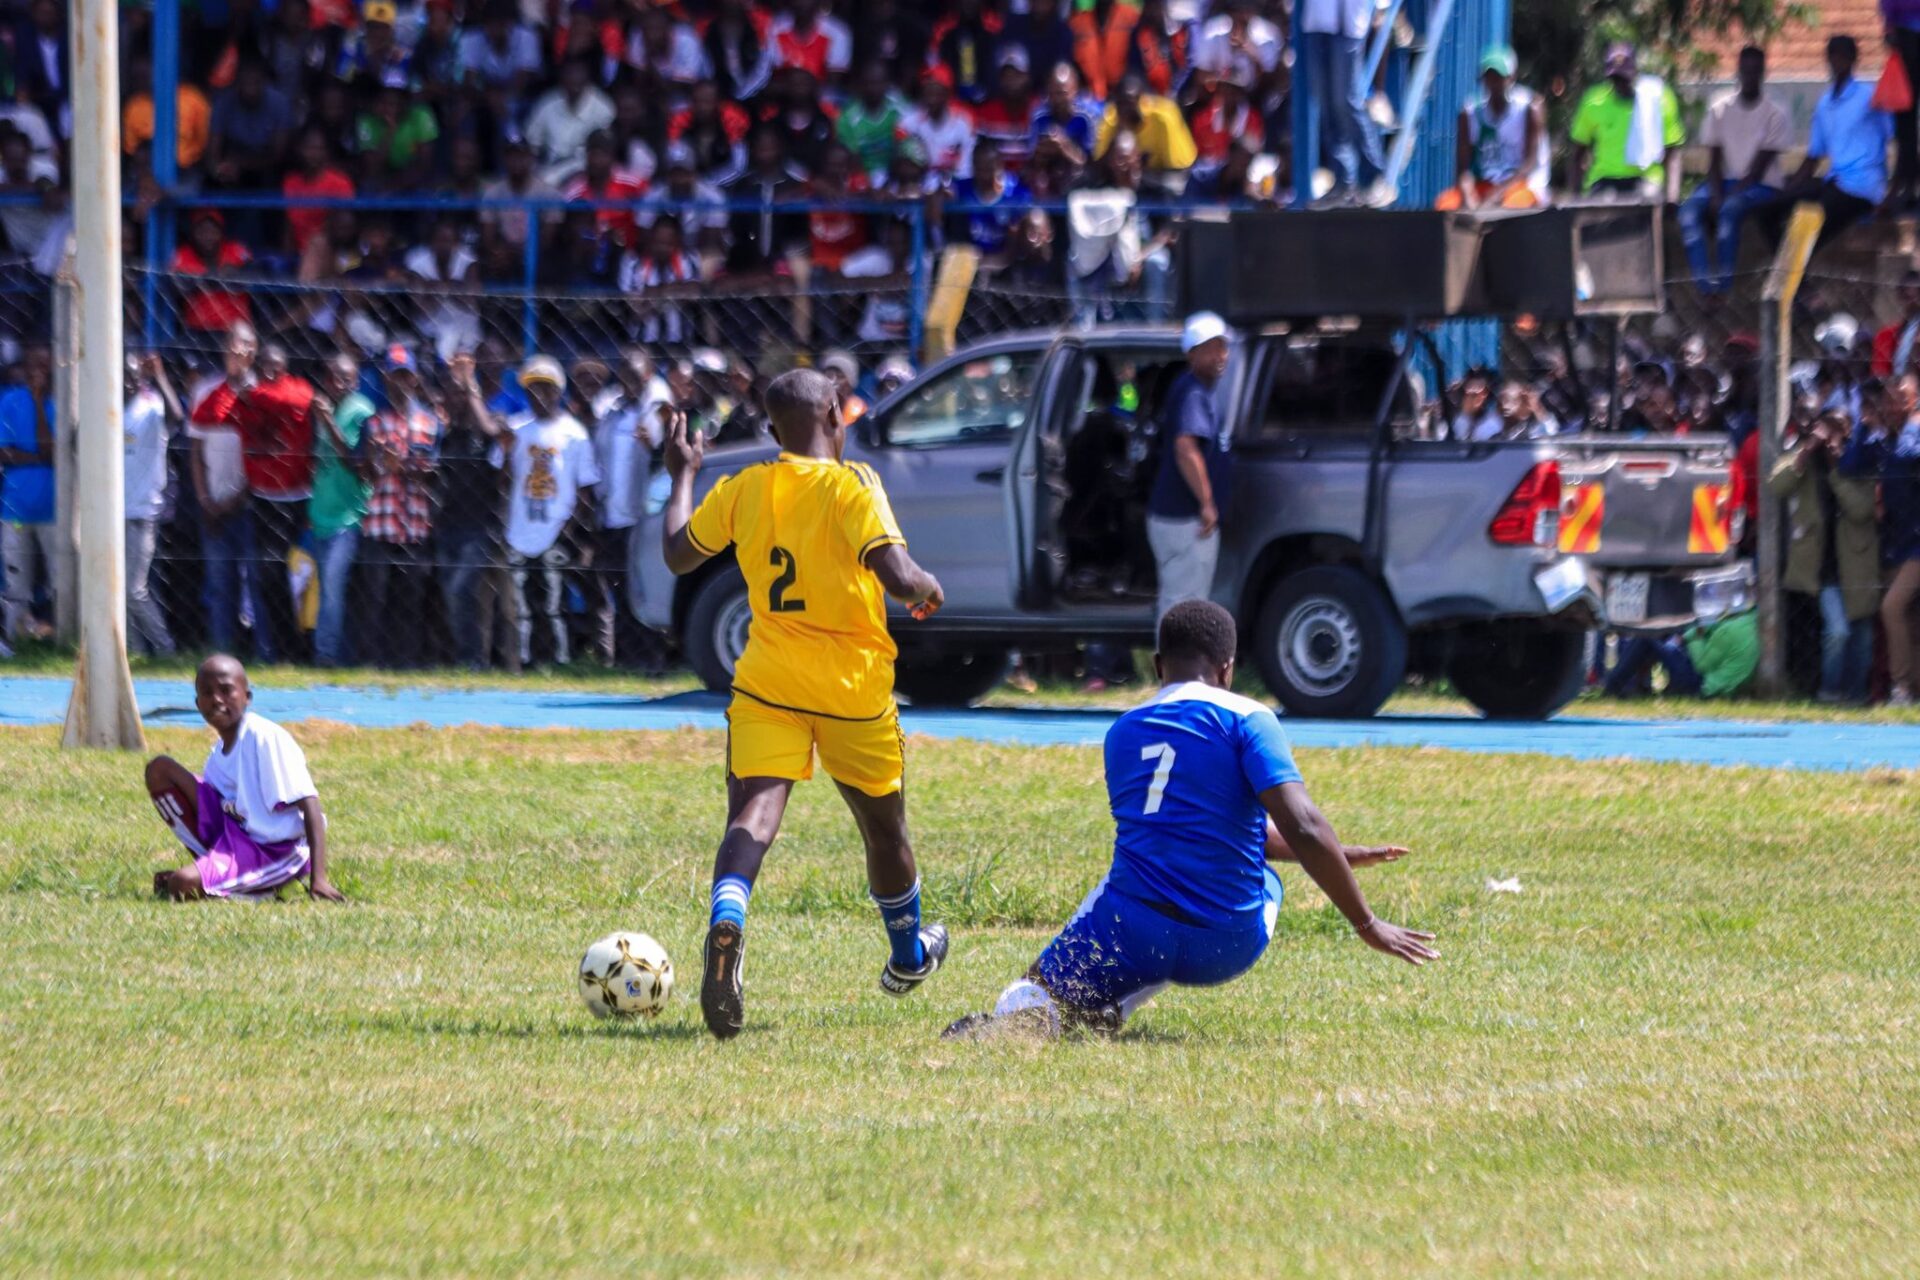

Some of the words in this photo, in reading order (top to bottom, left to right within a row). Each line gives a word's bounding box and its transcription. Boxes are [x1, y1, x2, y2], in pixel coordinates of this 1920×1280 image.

[769, 546, 806, 612] 2
[1141, 742, 1176, 815] 7
[881, 972, 911, 993] NIKE
